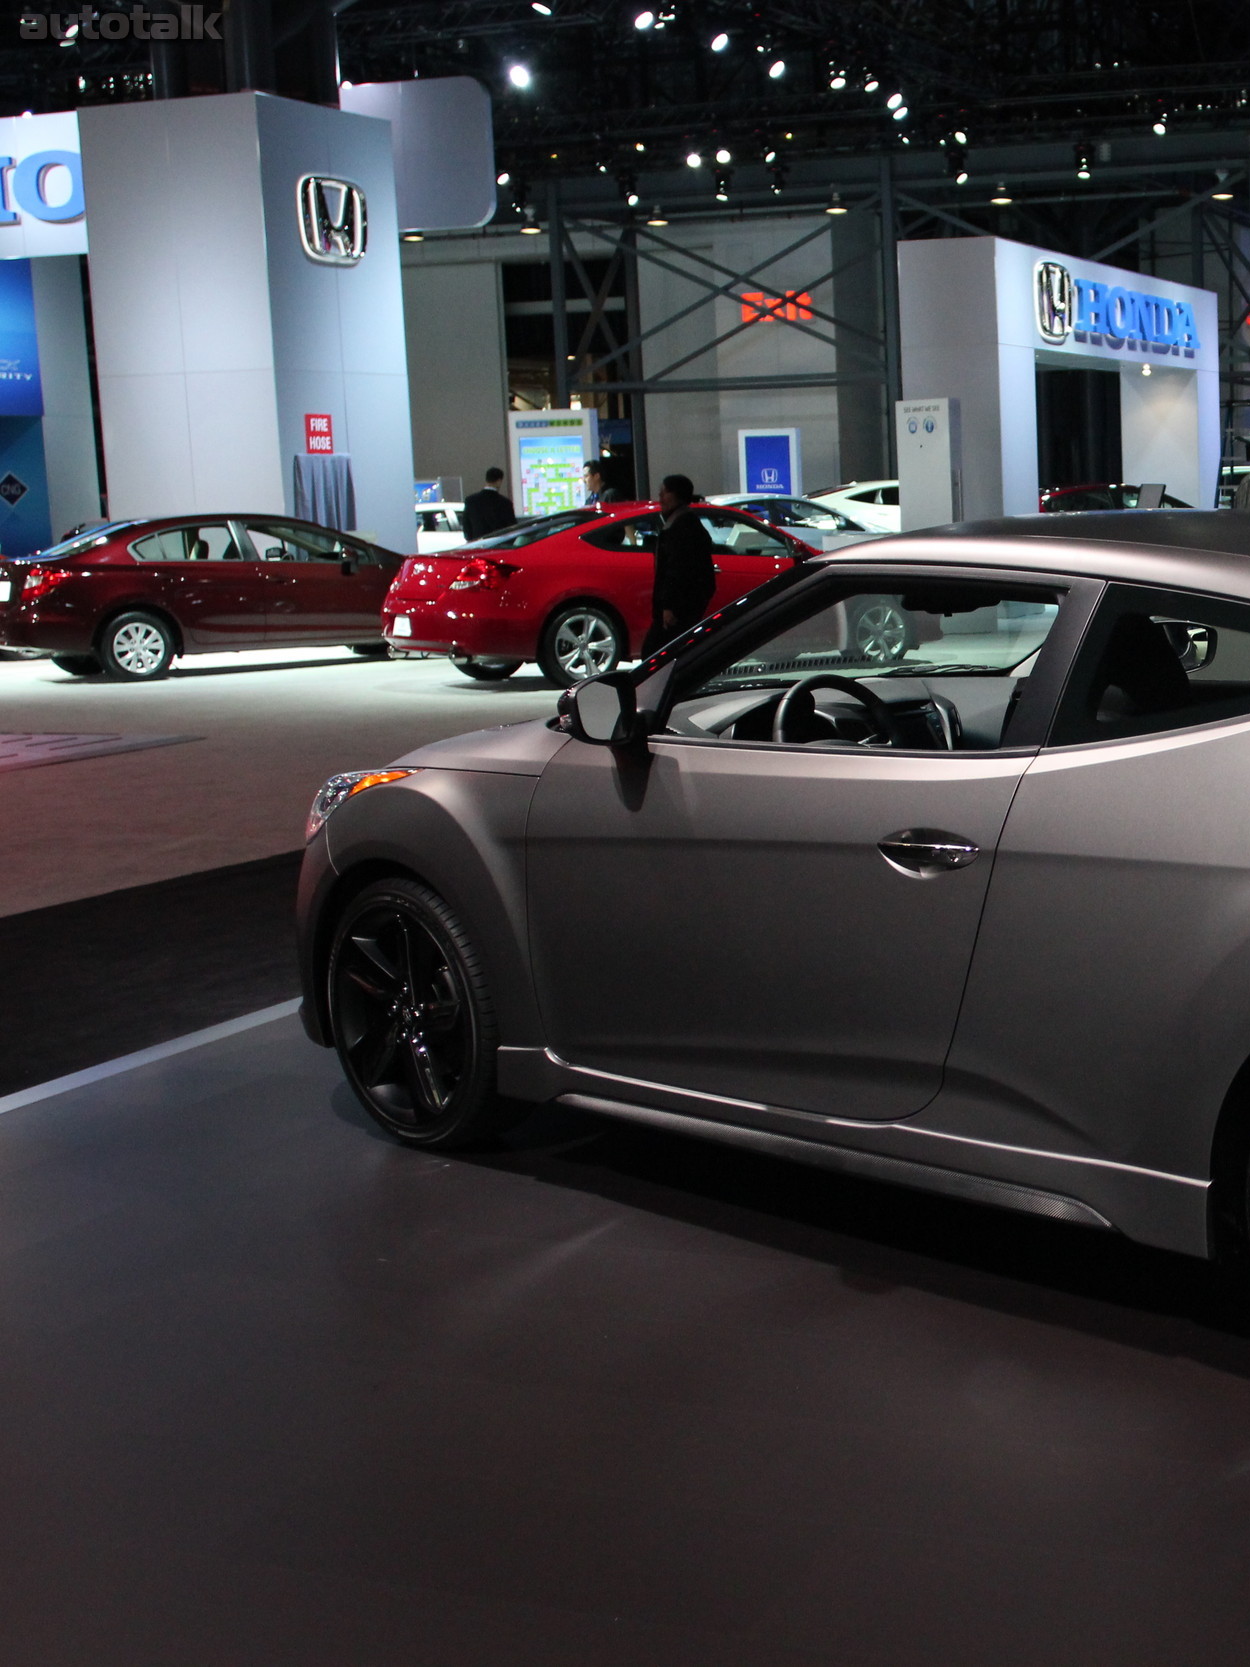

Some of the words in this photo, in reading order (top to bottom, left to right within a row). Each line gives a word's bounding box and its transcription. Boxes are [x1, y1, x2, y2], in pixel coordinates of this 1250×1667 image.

[1074, 278, 1200, 349] HONDA
[310, 417, 329, 432] FIRE
[309, 436, 331, 450] HOSE
